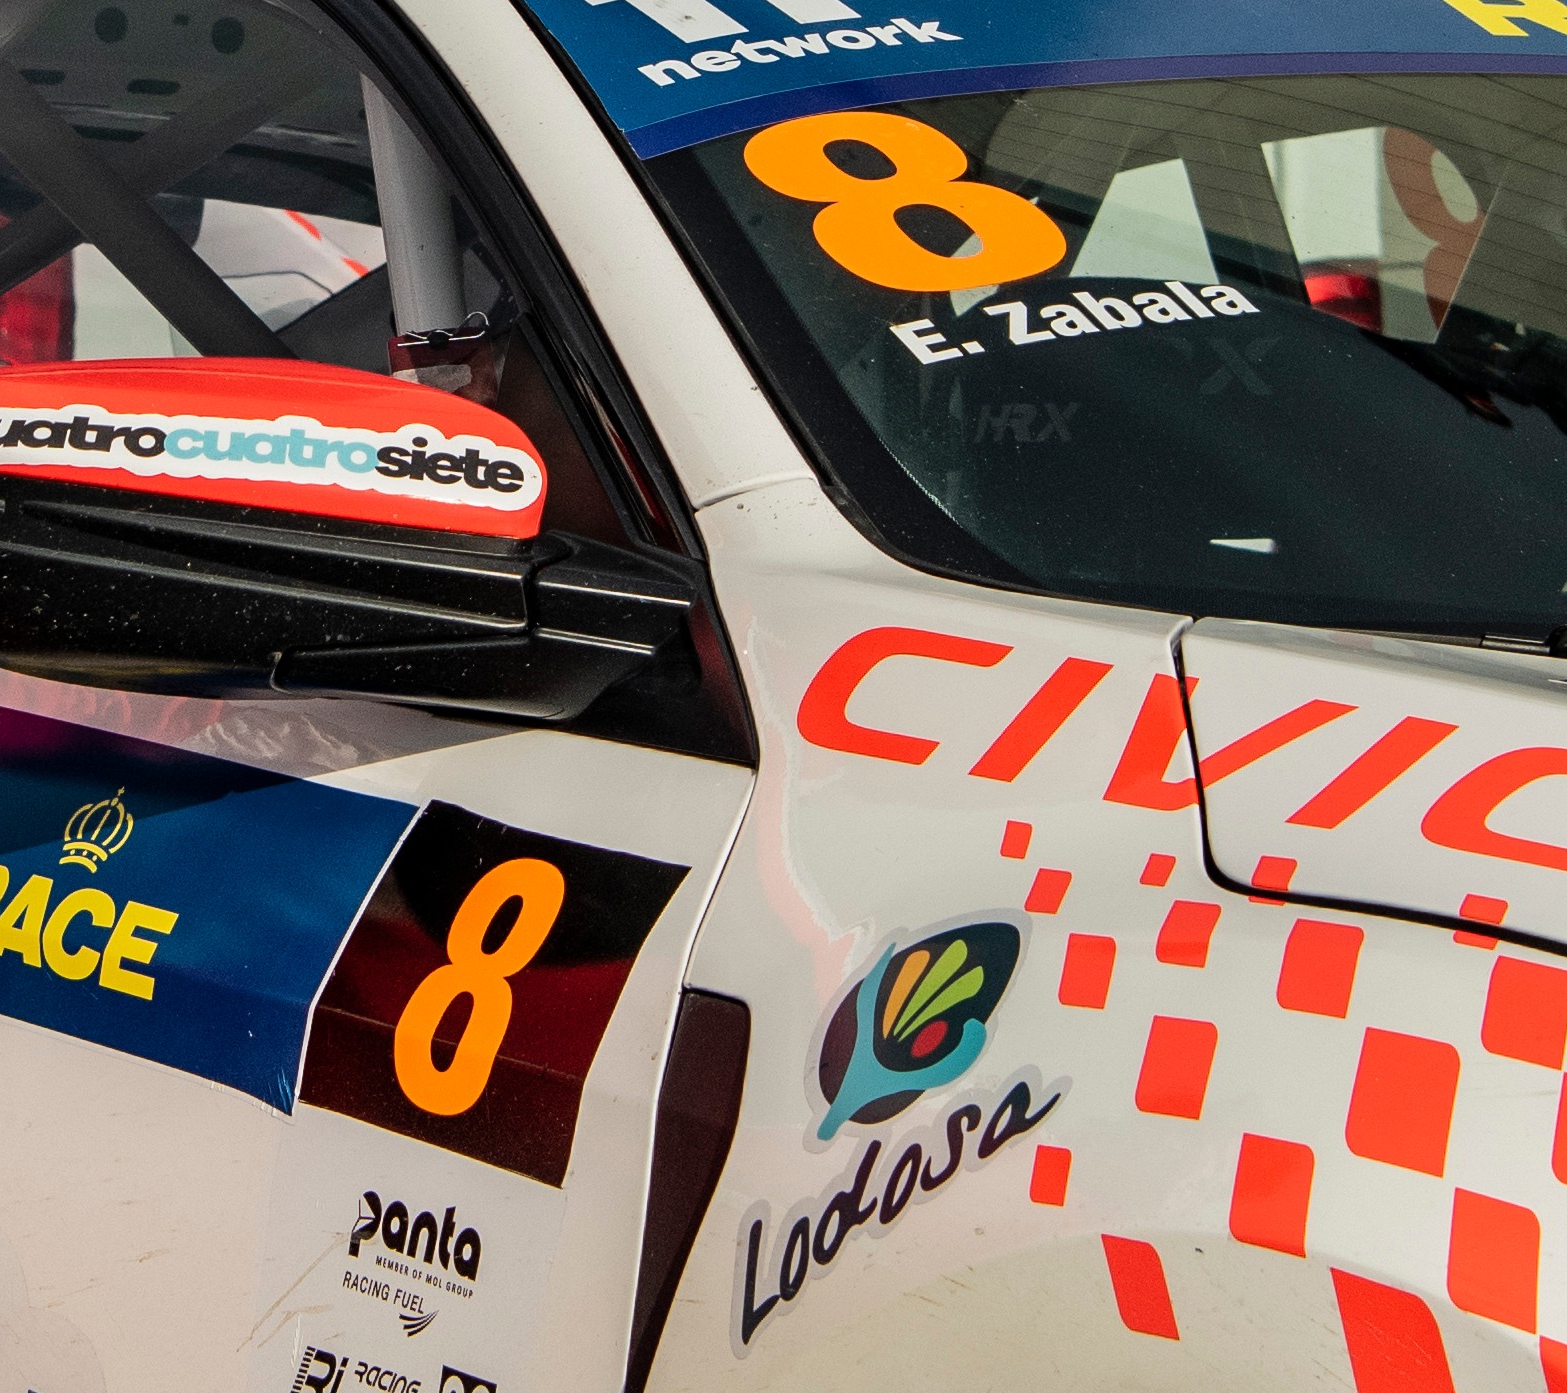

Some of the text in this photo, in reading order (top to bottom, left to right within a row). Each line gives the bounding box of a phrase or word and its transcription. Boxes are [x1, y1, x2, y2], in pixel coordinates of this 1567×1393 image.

[636, 17, 963, 87] network
[743, 111, 1067, 292] 8
[889, 280, 1260, 365] E. Zabala
[394, 857, 566, 1117] 8
[348, 1190, 482, 1281] panta
[741, 1081, 1063, 1344] Lodosa
[342, 1270, 425, 1315] RACING FUEL
[375, 1255, 474, 1299] MEMBER OF MOL GROUP
